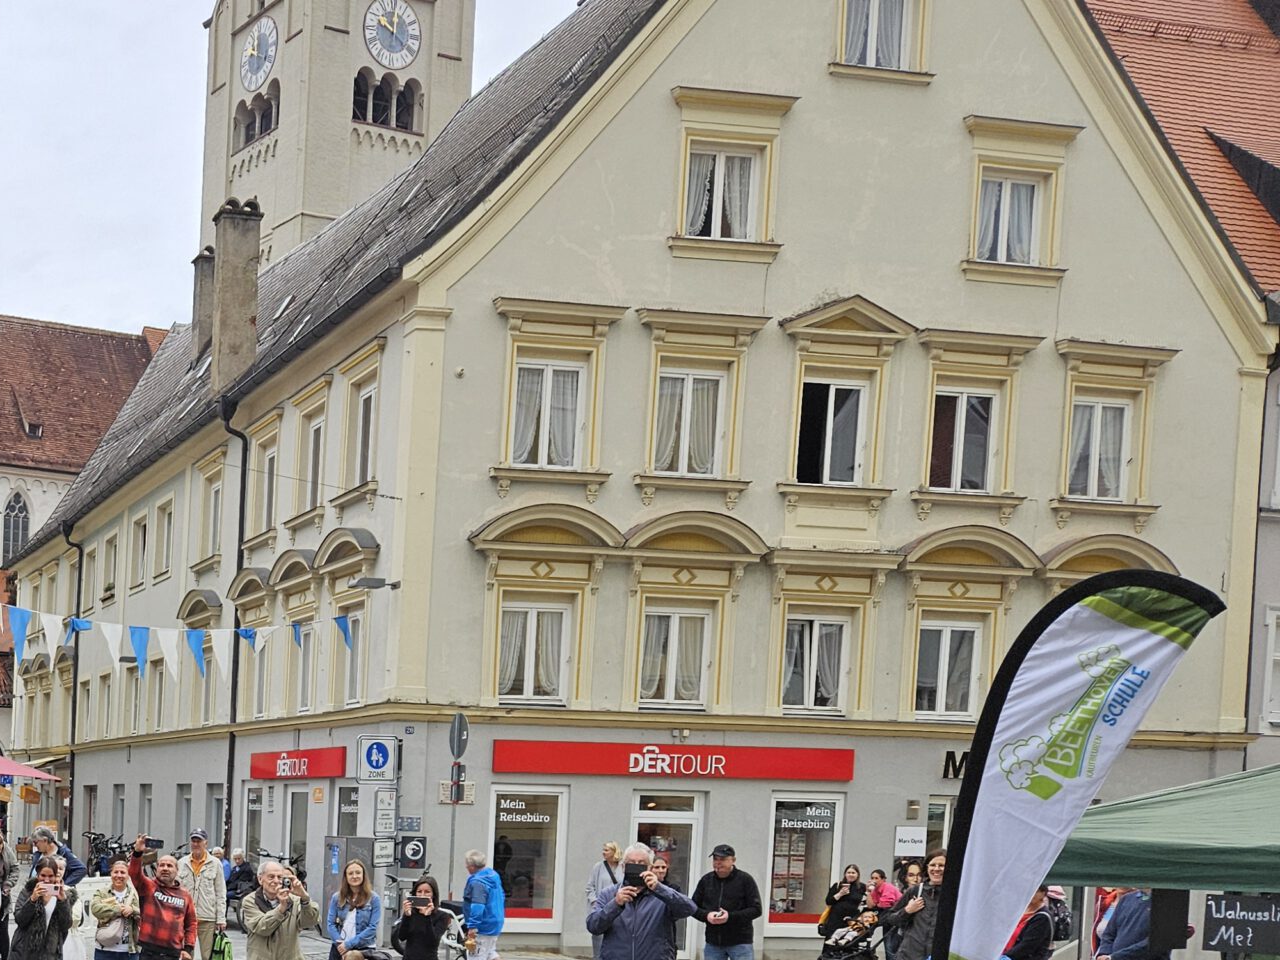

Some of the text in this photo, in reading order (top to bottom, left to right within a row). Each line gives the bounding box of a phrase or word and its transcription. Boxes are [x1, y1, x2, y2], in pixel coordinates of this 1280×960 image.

[1102, 665, 1150, 727] SCHULE
[1044, 658, 1129, 767] BEETHOVEN
[628, 746, 727, 775] DERTOUR
[500, 799, 526, 809] Mein
[806, 806, 831, 816] Mein
[500, 812, 551, 823] Reisebüro
[781, 818, 831, 829] Reisebüro
[154, 891, 185, 906] FUTURE
[1209, 925, 1253, 947] Met
